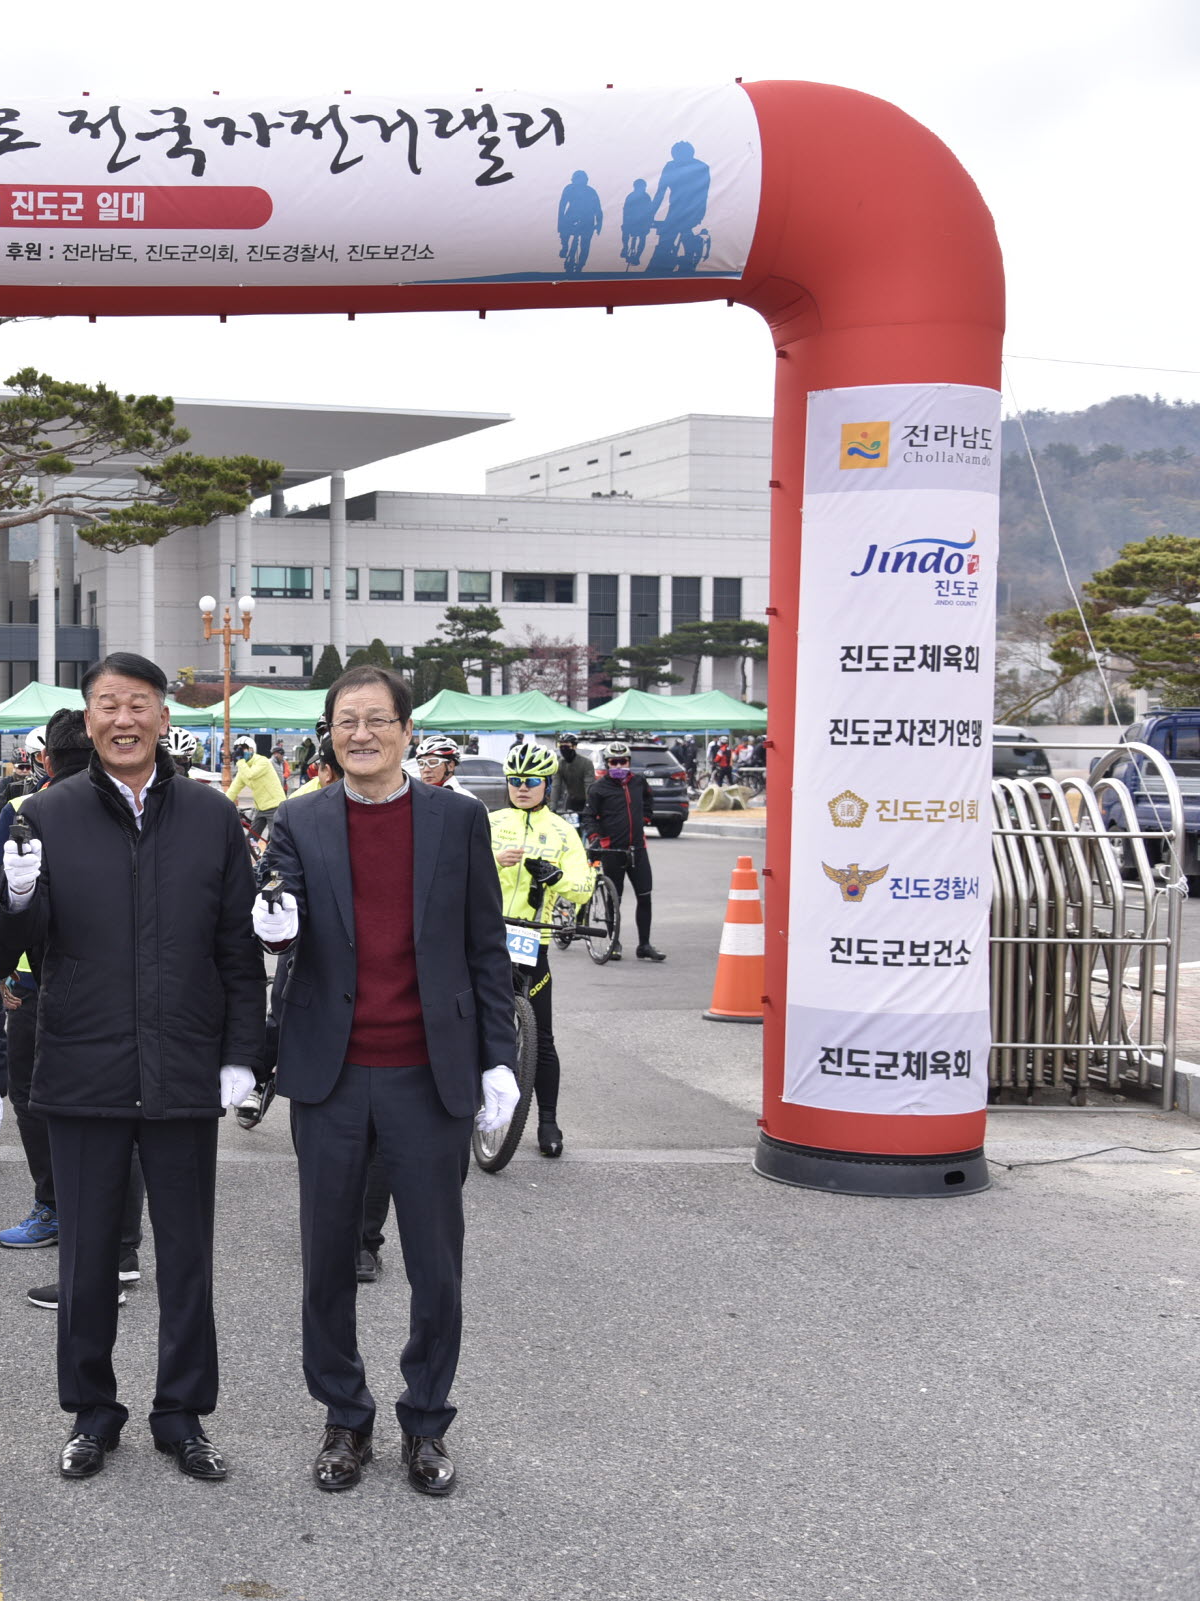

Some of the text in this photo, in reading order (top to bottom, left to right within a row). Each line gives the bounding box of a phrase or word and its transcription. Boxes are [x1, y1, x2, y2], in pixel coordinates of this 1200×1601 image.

[58, 104, 565, 187] 전국자전거랠리
[10, 190, 85, 221] 진도군
[97, 191, 145, 222] 일대
[62, 243, 138, 263] 전라남도,
[145, 243, 239, 263] 진도군의회,
[246, 243, 339, 263] 진도경찰서,
[347, 243, 435, 262] 진도보건소
[901, 424, 993, 451] 전라남도
[903, 451, 991, 467] ChollaNamdo
[850, 544, 965, 577] Jindo
[934, 579, 979, 599] 진도군
[839, 644, 980, 674] 진도군체육회
[828, 718, 983, 748] 진도군자전거연맹
[875, 798, 980, 823] 진도군의회
[888, 876, 979, 901] 진도경찰서
[829, 936, 972, 968] 진도군보건소
[818, 1046, 972, 1081] 진도군체육회
